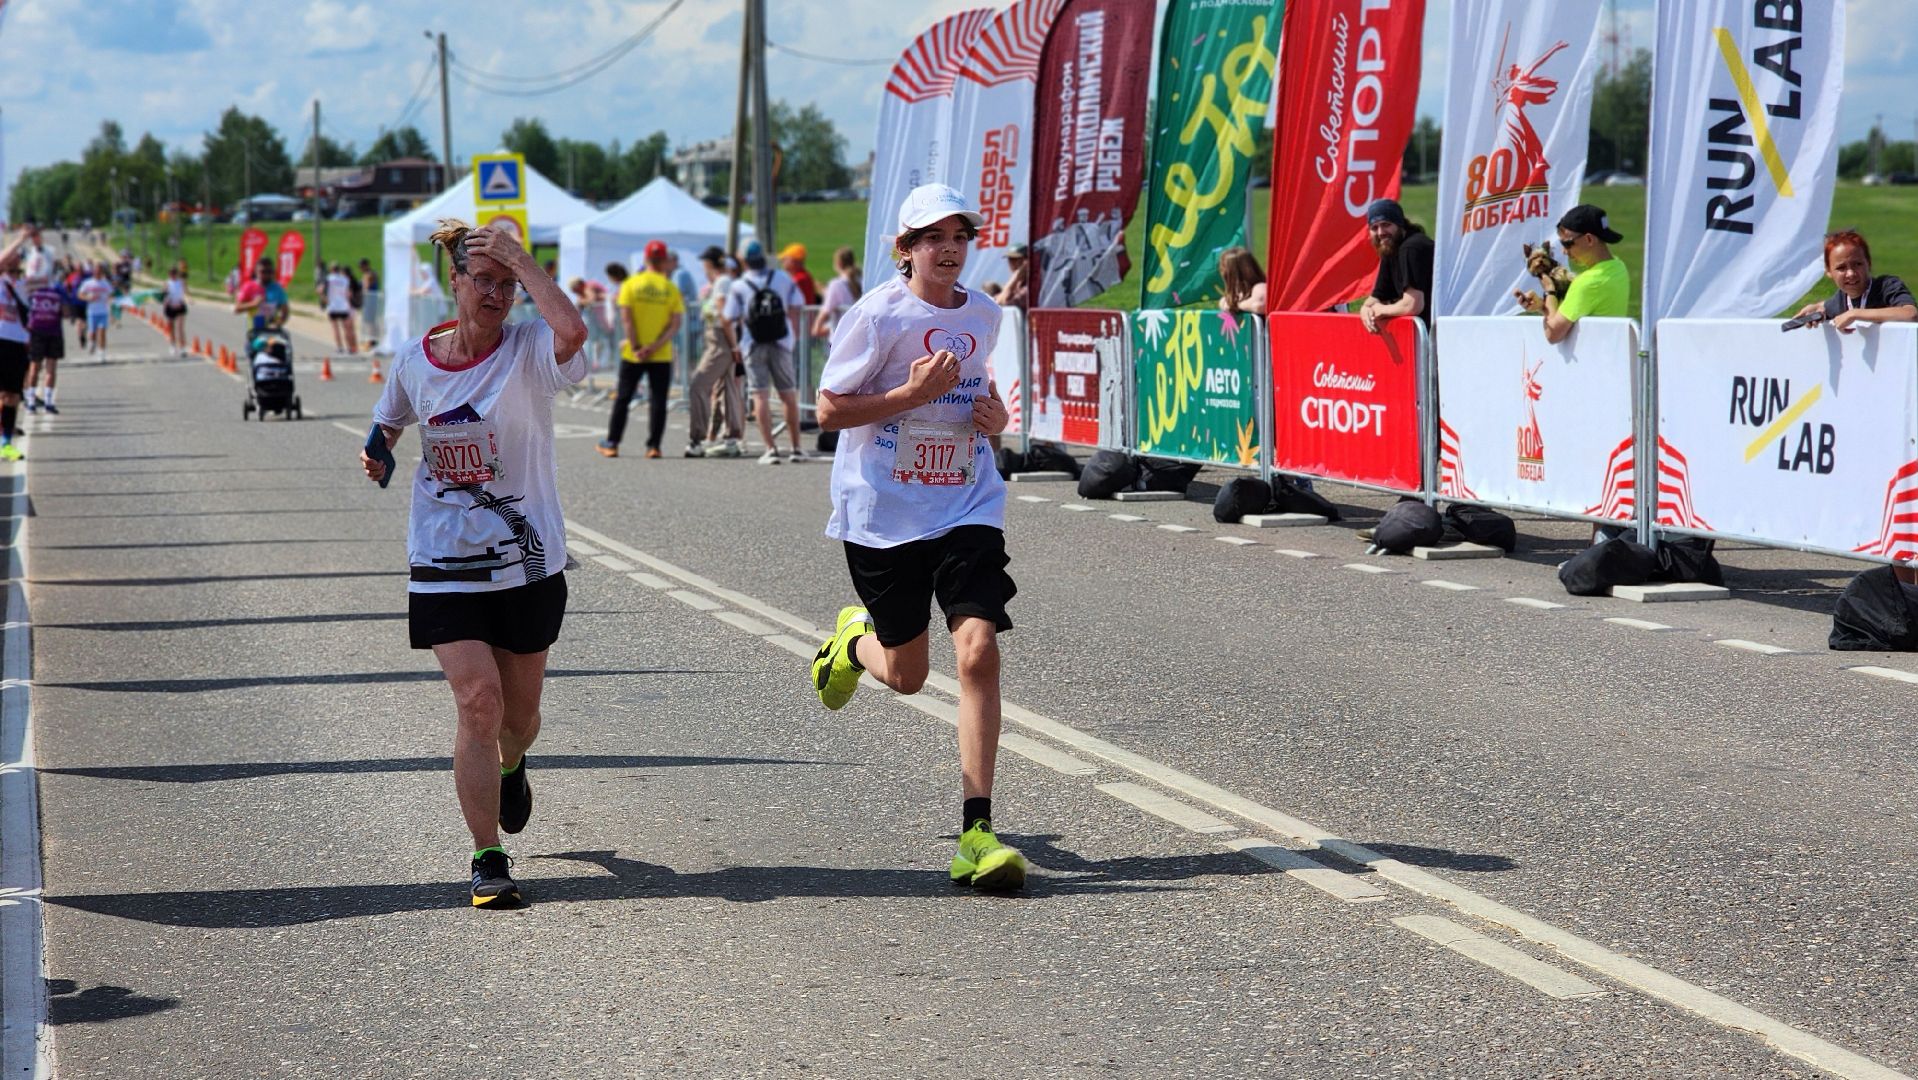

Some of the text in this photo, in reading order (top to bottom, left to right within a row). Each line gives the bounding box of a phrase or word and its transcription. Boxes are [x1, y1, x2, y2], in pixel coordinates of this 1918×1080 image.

[1753, 0, 1802, 119] LAB
[1073, 10, 1104, 197] ВОЛОКОЛАМСКИЙ
[1316, 12, 1349, 183] Советский
[1054, 61, 1075, 201] Полумарафон
[1096, 117, 1125, 192] РУБЕЖ
[1466, 149, 1513, 203] 80
[1706, 98, 1755, 234] RUN
[992, 154, 1017, 248] СПОРТ
[1463, 194, 1549, 236] ПОБЕДА!
[1313, 361, 1376, 392] Советский
[1729, 375, 1790, 428] RUN
[1301, 396, 1387, 437] СПОРТ
[432, 443, 483, 470] 3070
[914, 444, 956, 470] 3117
[1777, 421, 1836, 475] LAB
